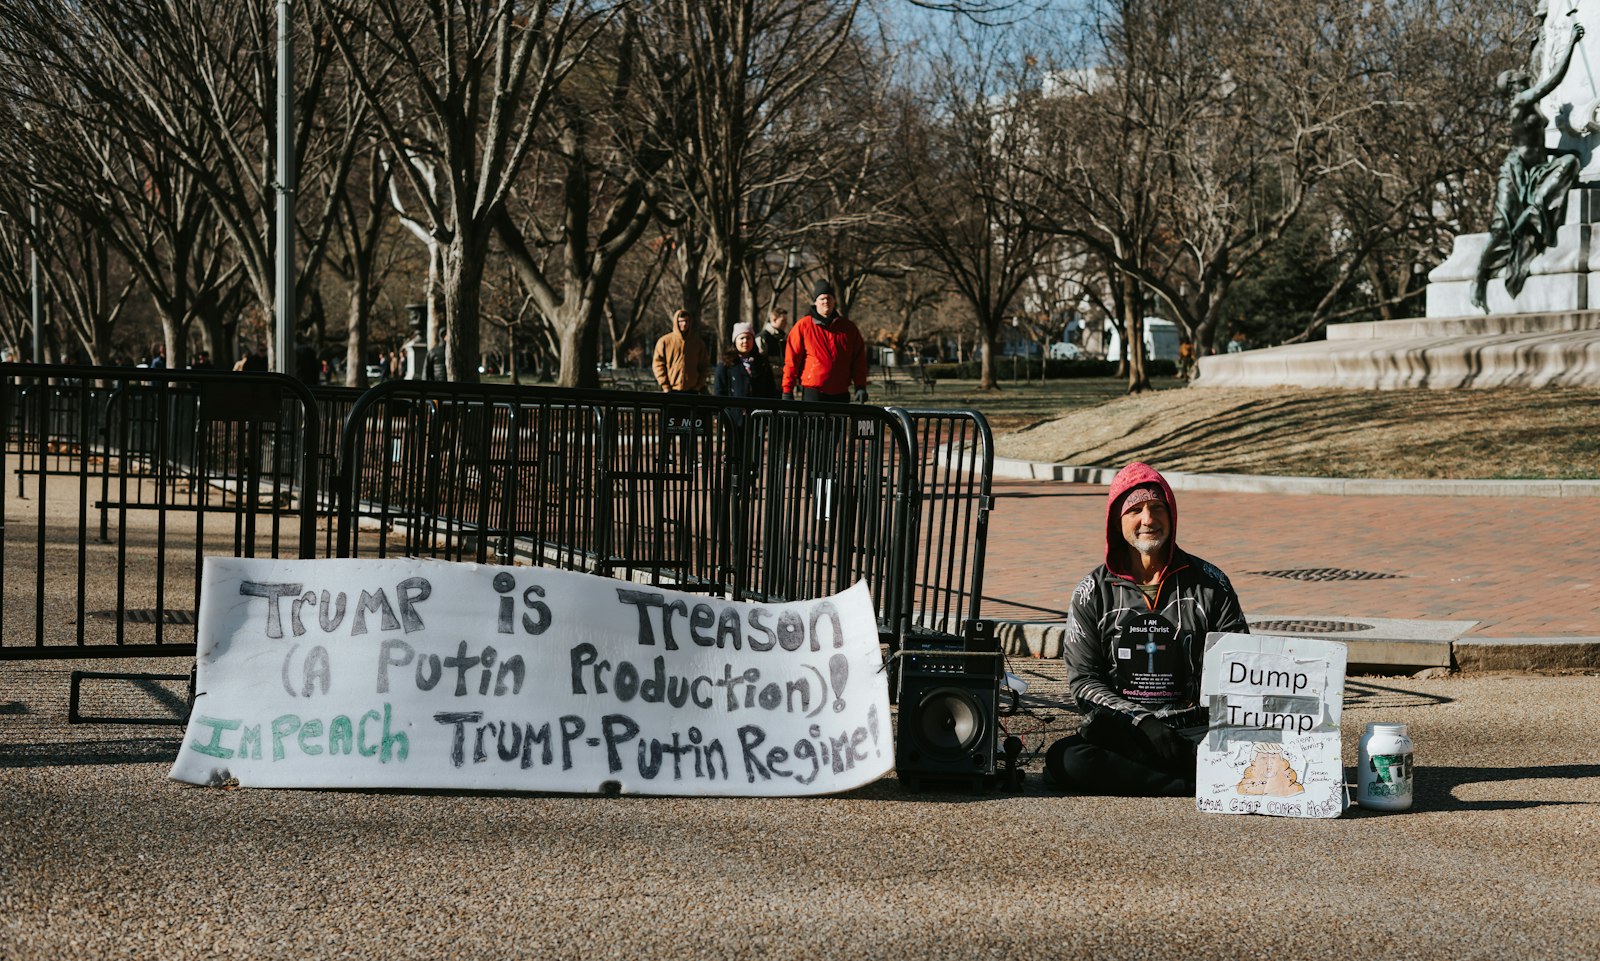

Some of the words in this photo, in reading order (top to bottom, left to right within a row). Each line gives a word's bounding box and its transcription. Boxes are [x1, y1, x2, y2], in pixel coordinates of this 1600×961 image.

[668, 417, 703, 428] SNO
[857, 420, 875, 436] PRPA
[492, 572, 552, 636] is
[1129, 625, 1148, 633] Jesus
[376, 638, 526, 697] Putin
[1229, 661, 1308, 694] Dump
[1227, 704, 1314, 735] Trump
